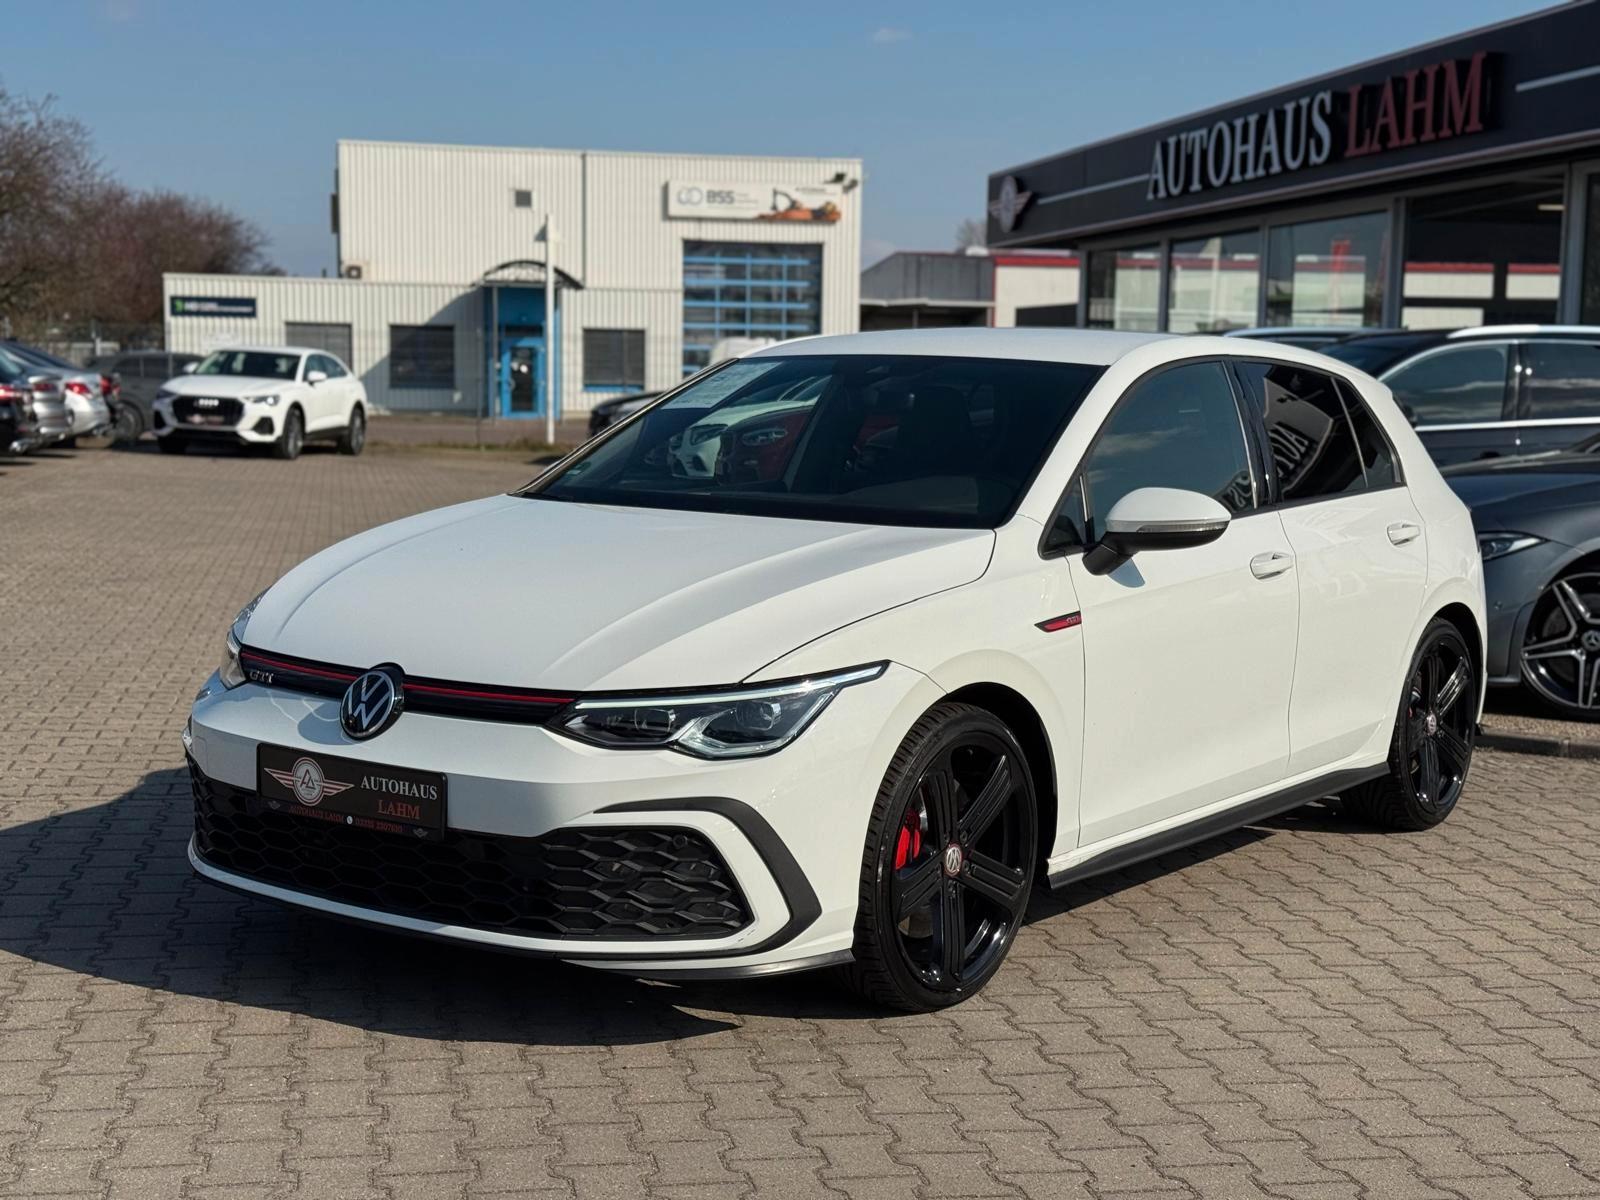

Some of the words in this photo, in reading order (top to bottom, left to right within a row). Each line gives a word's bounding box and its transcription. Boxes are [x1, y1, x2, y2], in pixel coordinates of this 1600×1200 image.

[1147, 90, 1332, 200] AUTOHAUS
[1343, 51, 1488, 157] LAHM
[250, 670, 275, 684] GTI
[342, 671, 394, 736] VW
[360, 775, 438, 801] AUTOHAUS
[377, 799, 421, 820] LAHM
